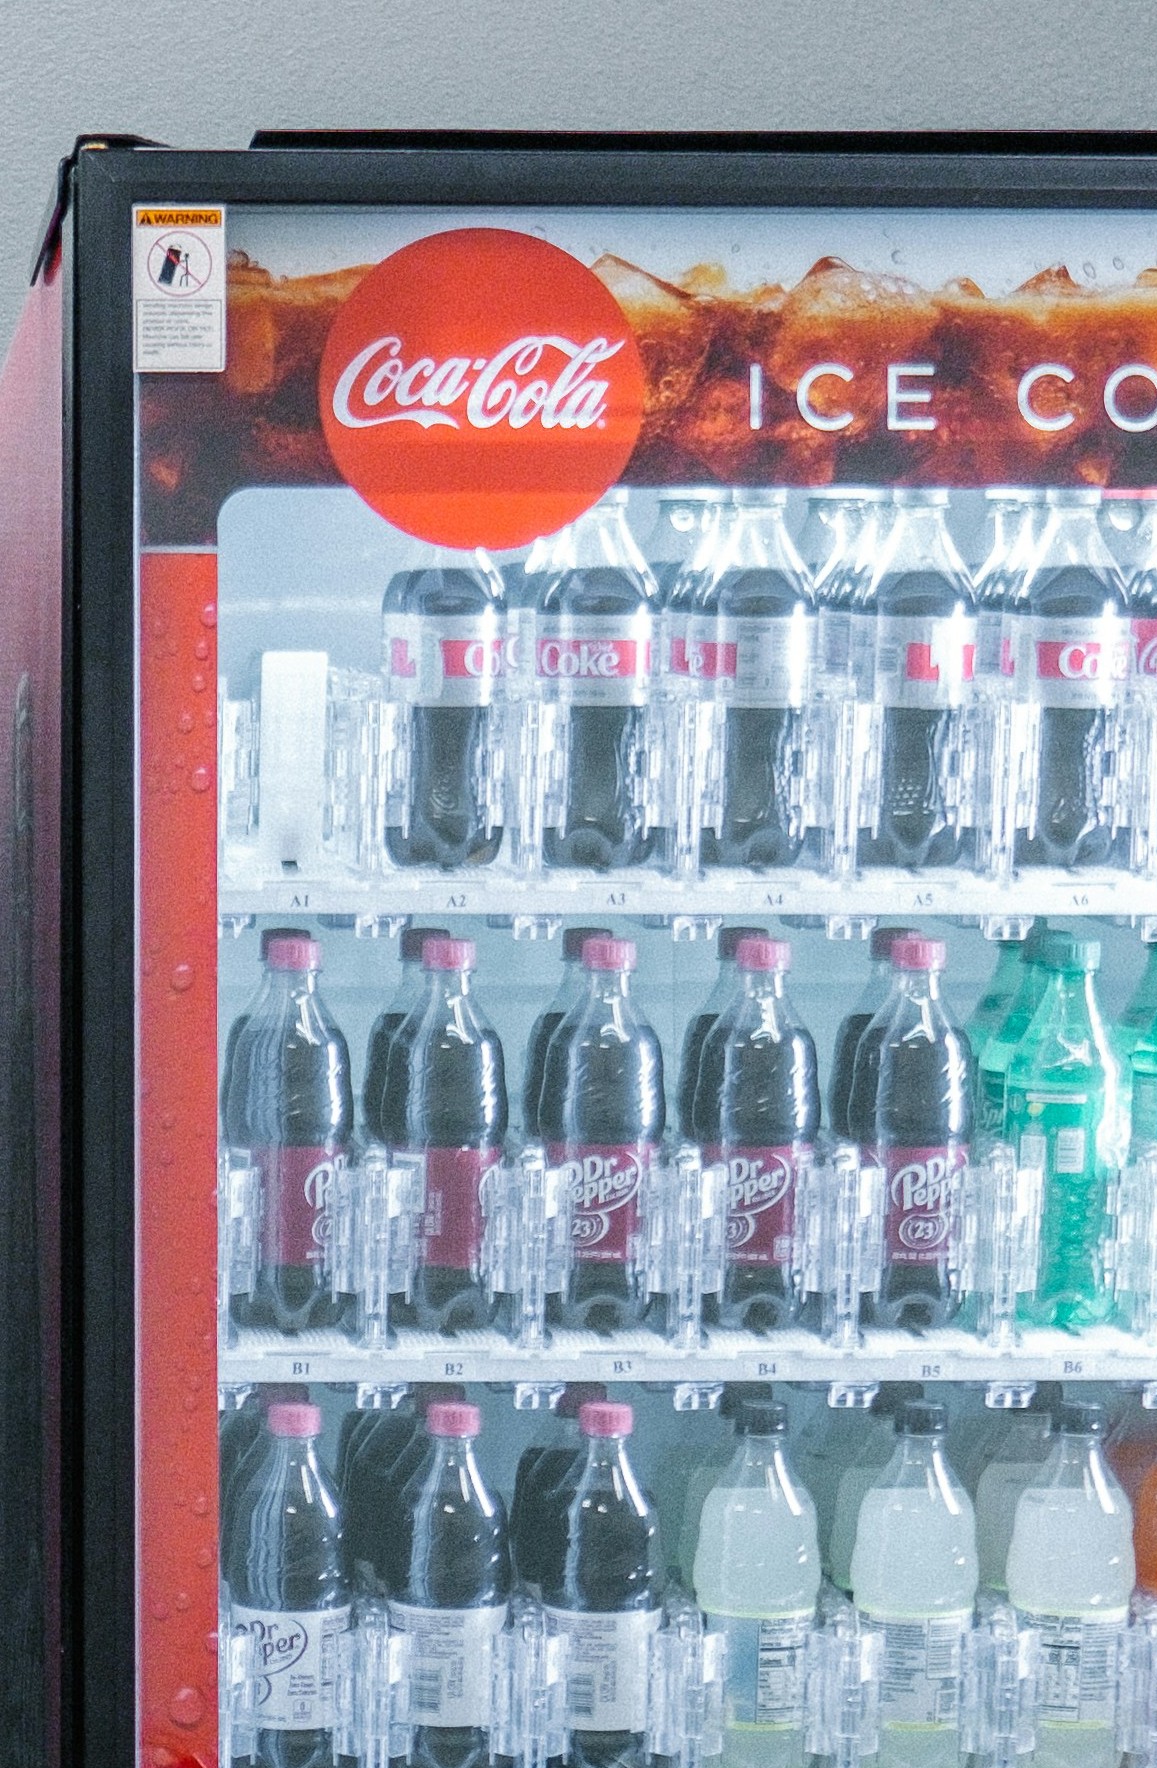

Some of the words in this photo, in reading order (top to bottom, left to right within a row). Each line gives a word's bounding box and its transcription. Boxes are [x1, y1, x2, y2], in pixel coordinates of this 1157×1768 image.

[154, 213, 218, 224] WARNING
[333, 336, 625, 428] Coca-Cola
[749, 363, 935, 431] ICE
[542, 641, 620, 677] Coke
[291, 895, 309, 907] A1
[446, 895, 466, 907] A2
[606, 893, 626, 905] A3
[765, 893, 783, 905] A4
[913, 893, 934, 906] A5
[583, 1155, 618, 1182] Dr
[729, 1158, 763, 1184] Dr
[915, 1221, 933, 1240] 23
[293, 1362, 310, 1375] B1
[445, 1362, 464, 1375] B2
[614, 1361, 632, 1374] B3
[758, 1363, 776, 1376] B4
[921, 1365, 941, 1378] B5
[1063, 1361, 1082, 1374] B6
